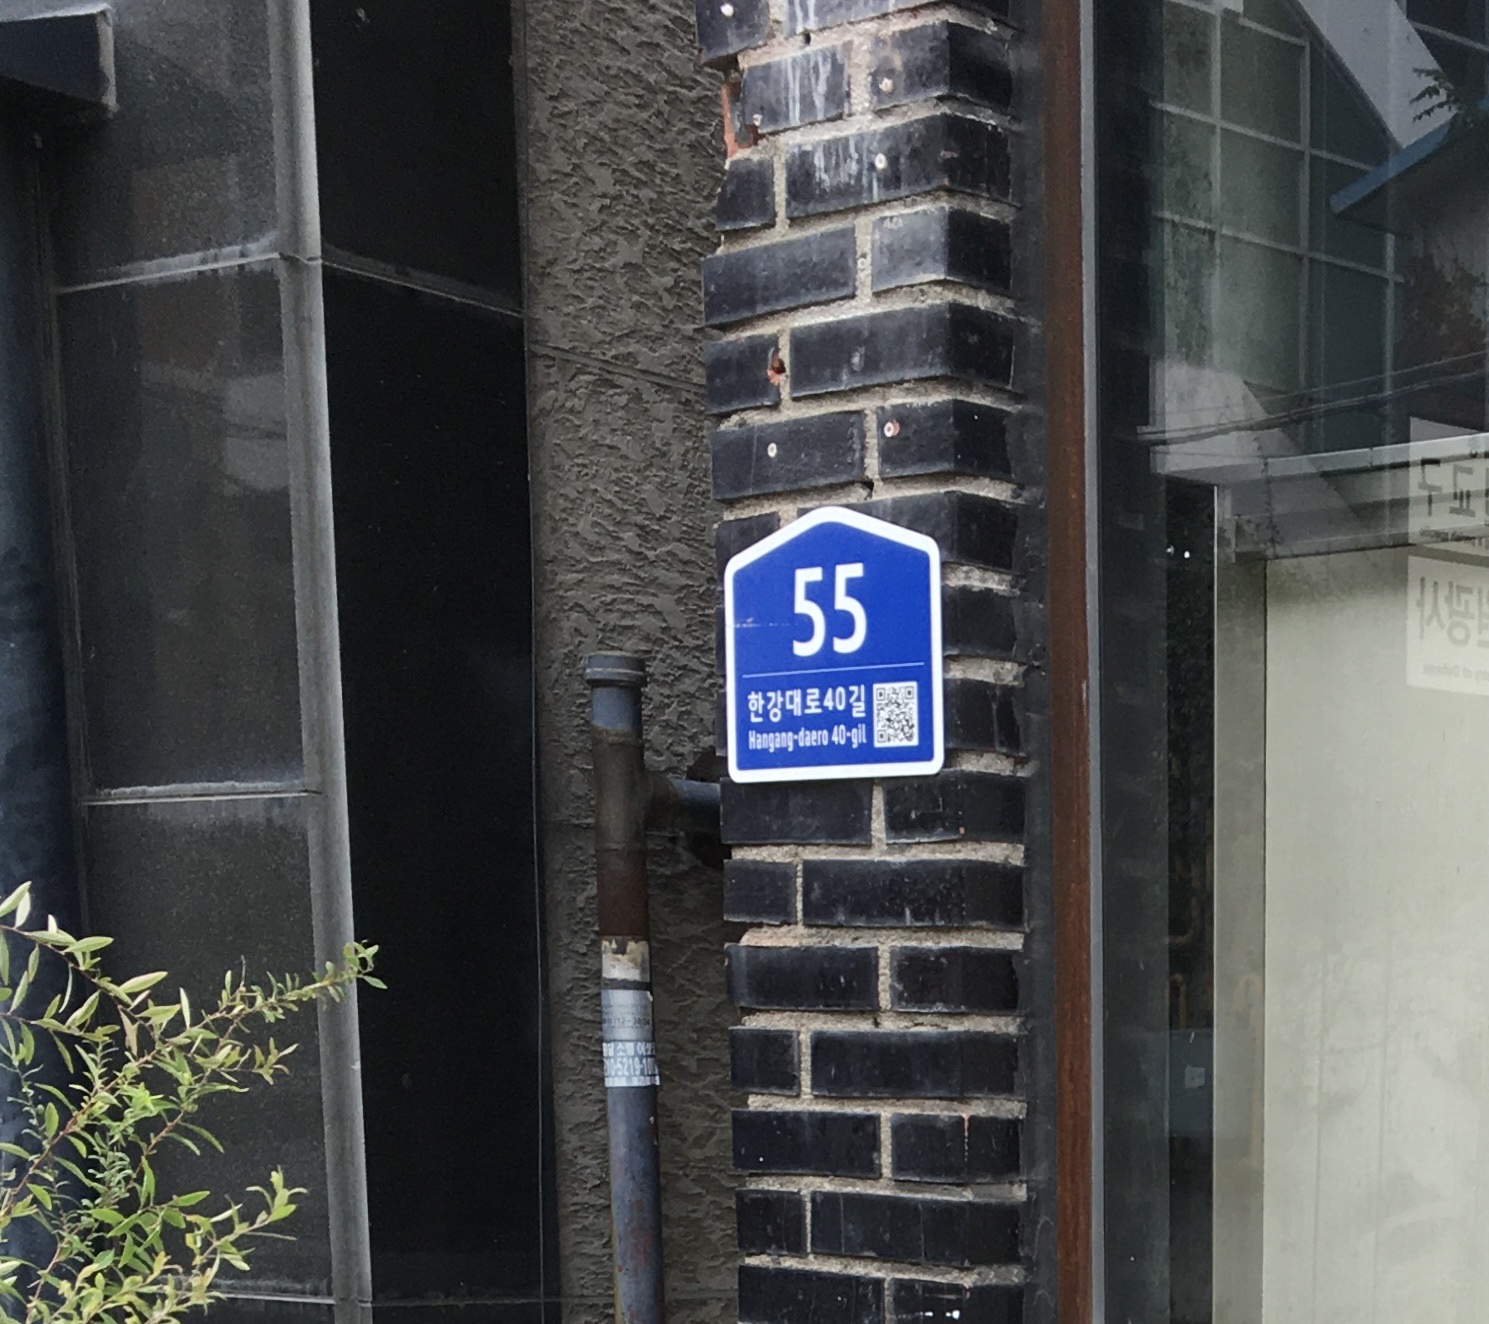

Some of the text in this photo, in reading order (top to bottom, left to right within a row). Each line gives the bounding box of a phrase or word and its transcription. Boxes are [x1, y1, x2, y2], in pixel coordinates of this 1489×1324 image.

[793, 562, 868, 657] 55
[748, 684, 867, 724] 한강대로40길
[748, 724, 867, 753] Hangang-daero 40-gil
